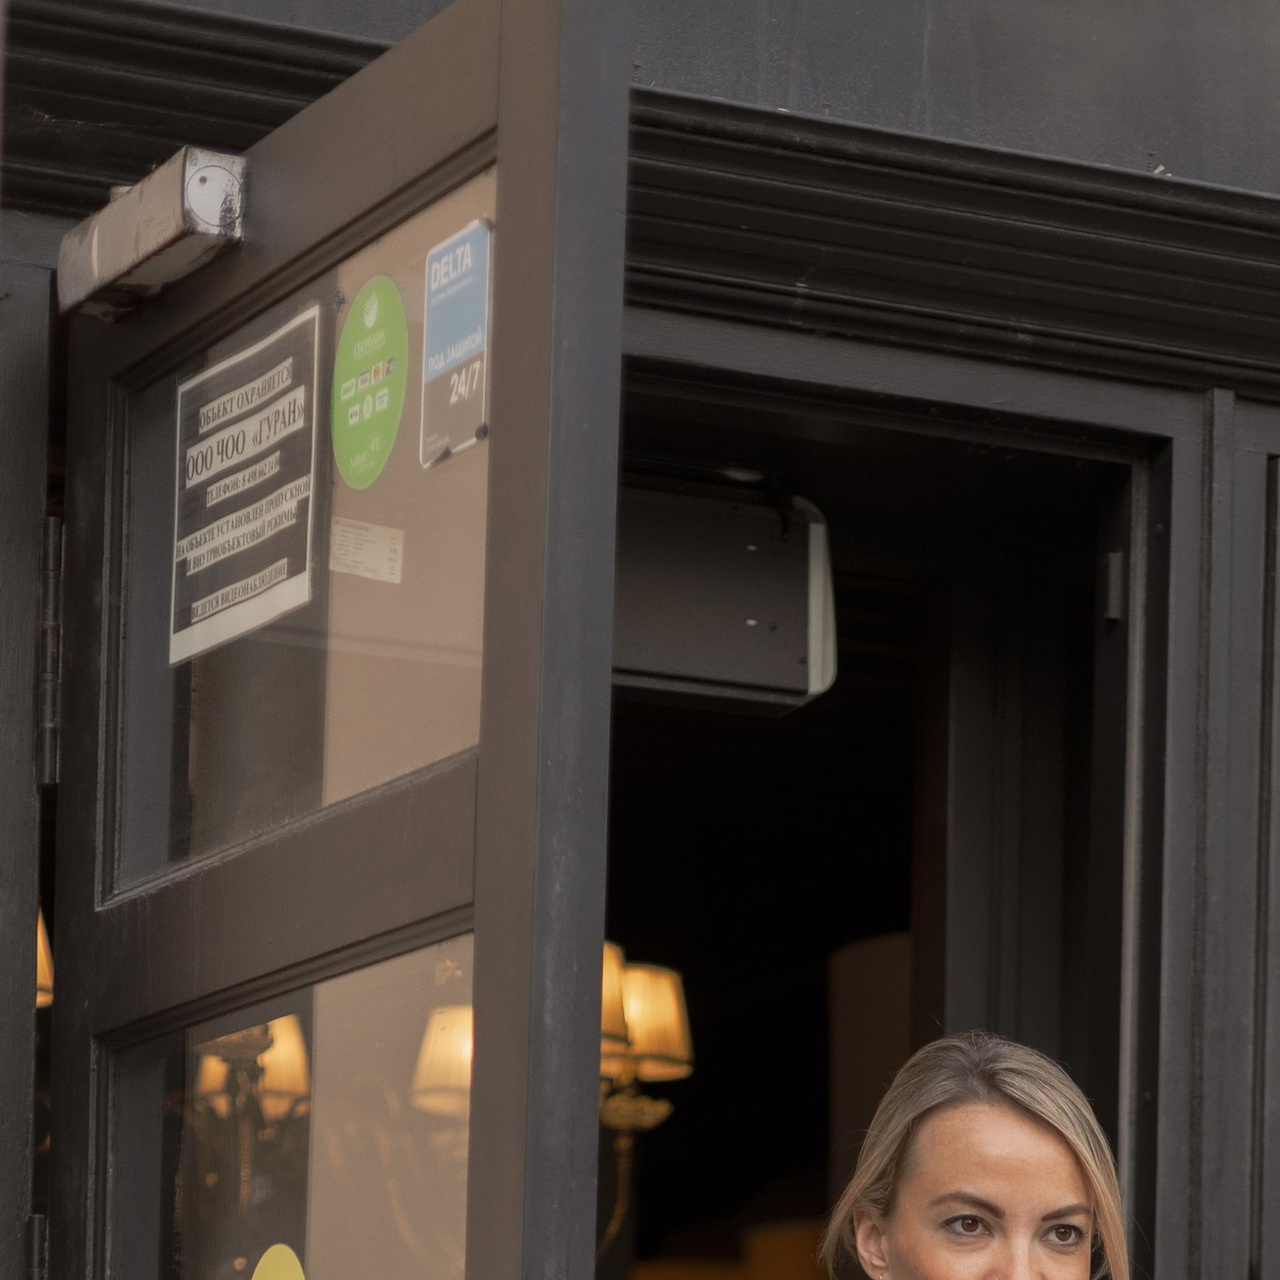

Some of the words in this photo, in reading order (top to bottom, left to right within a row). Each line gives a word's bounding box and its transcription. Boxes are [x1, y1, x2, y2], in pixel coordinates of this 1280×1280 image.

[431, 241, 472, 291] DELTA
[428, 351, 445, 373] ПОД
[447, 326, 482, 362] ЗАЩИТОЙ
[200, 396, 235, 429] ОБЪЕКТ
[237, 361, 292, 409] ОХРАНЯЕТСЯ
[450, 360, 481, 404] 24/7
[186, 445, 214, 481] ООО
[216, 429, 246, 464] ЧОО
[252, 397, 305, 447] «ГУРАН»
[176, 543, 185, 559] НА
[186, 527, 216, 555] ОБЪЕКТЕ
[216, 506, 264, 538] УСТАНОВЛЕН
[264, 476, 311, 517] ПРОПУСКНОЙ
[207, 479, 242, 504] ТЕЛЕФОН:
[192, 520, 265, 570] ВНУТРИОБЪЕКТОВЫЙ
[266, 506, 296, 534] РЕЖИМЫ
[191, 592, 220, 619] ВЕДЕТСЯ
[220, 563, 286, 608] ВИДЕОНАБЛЮДЕНИЕ
